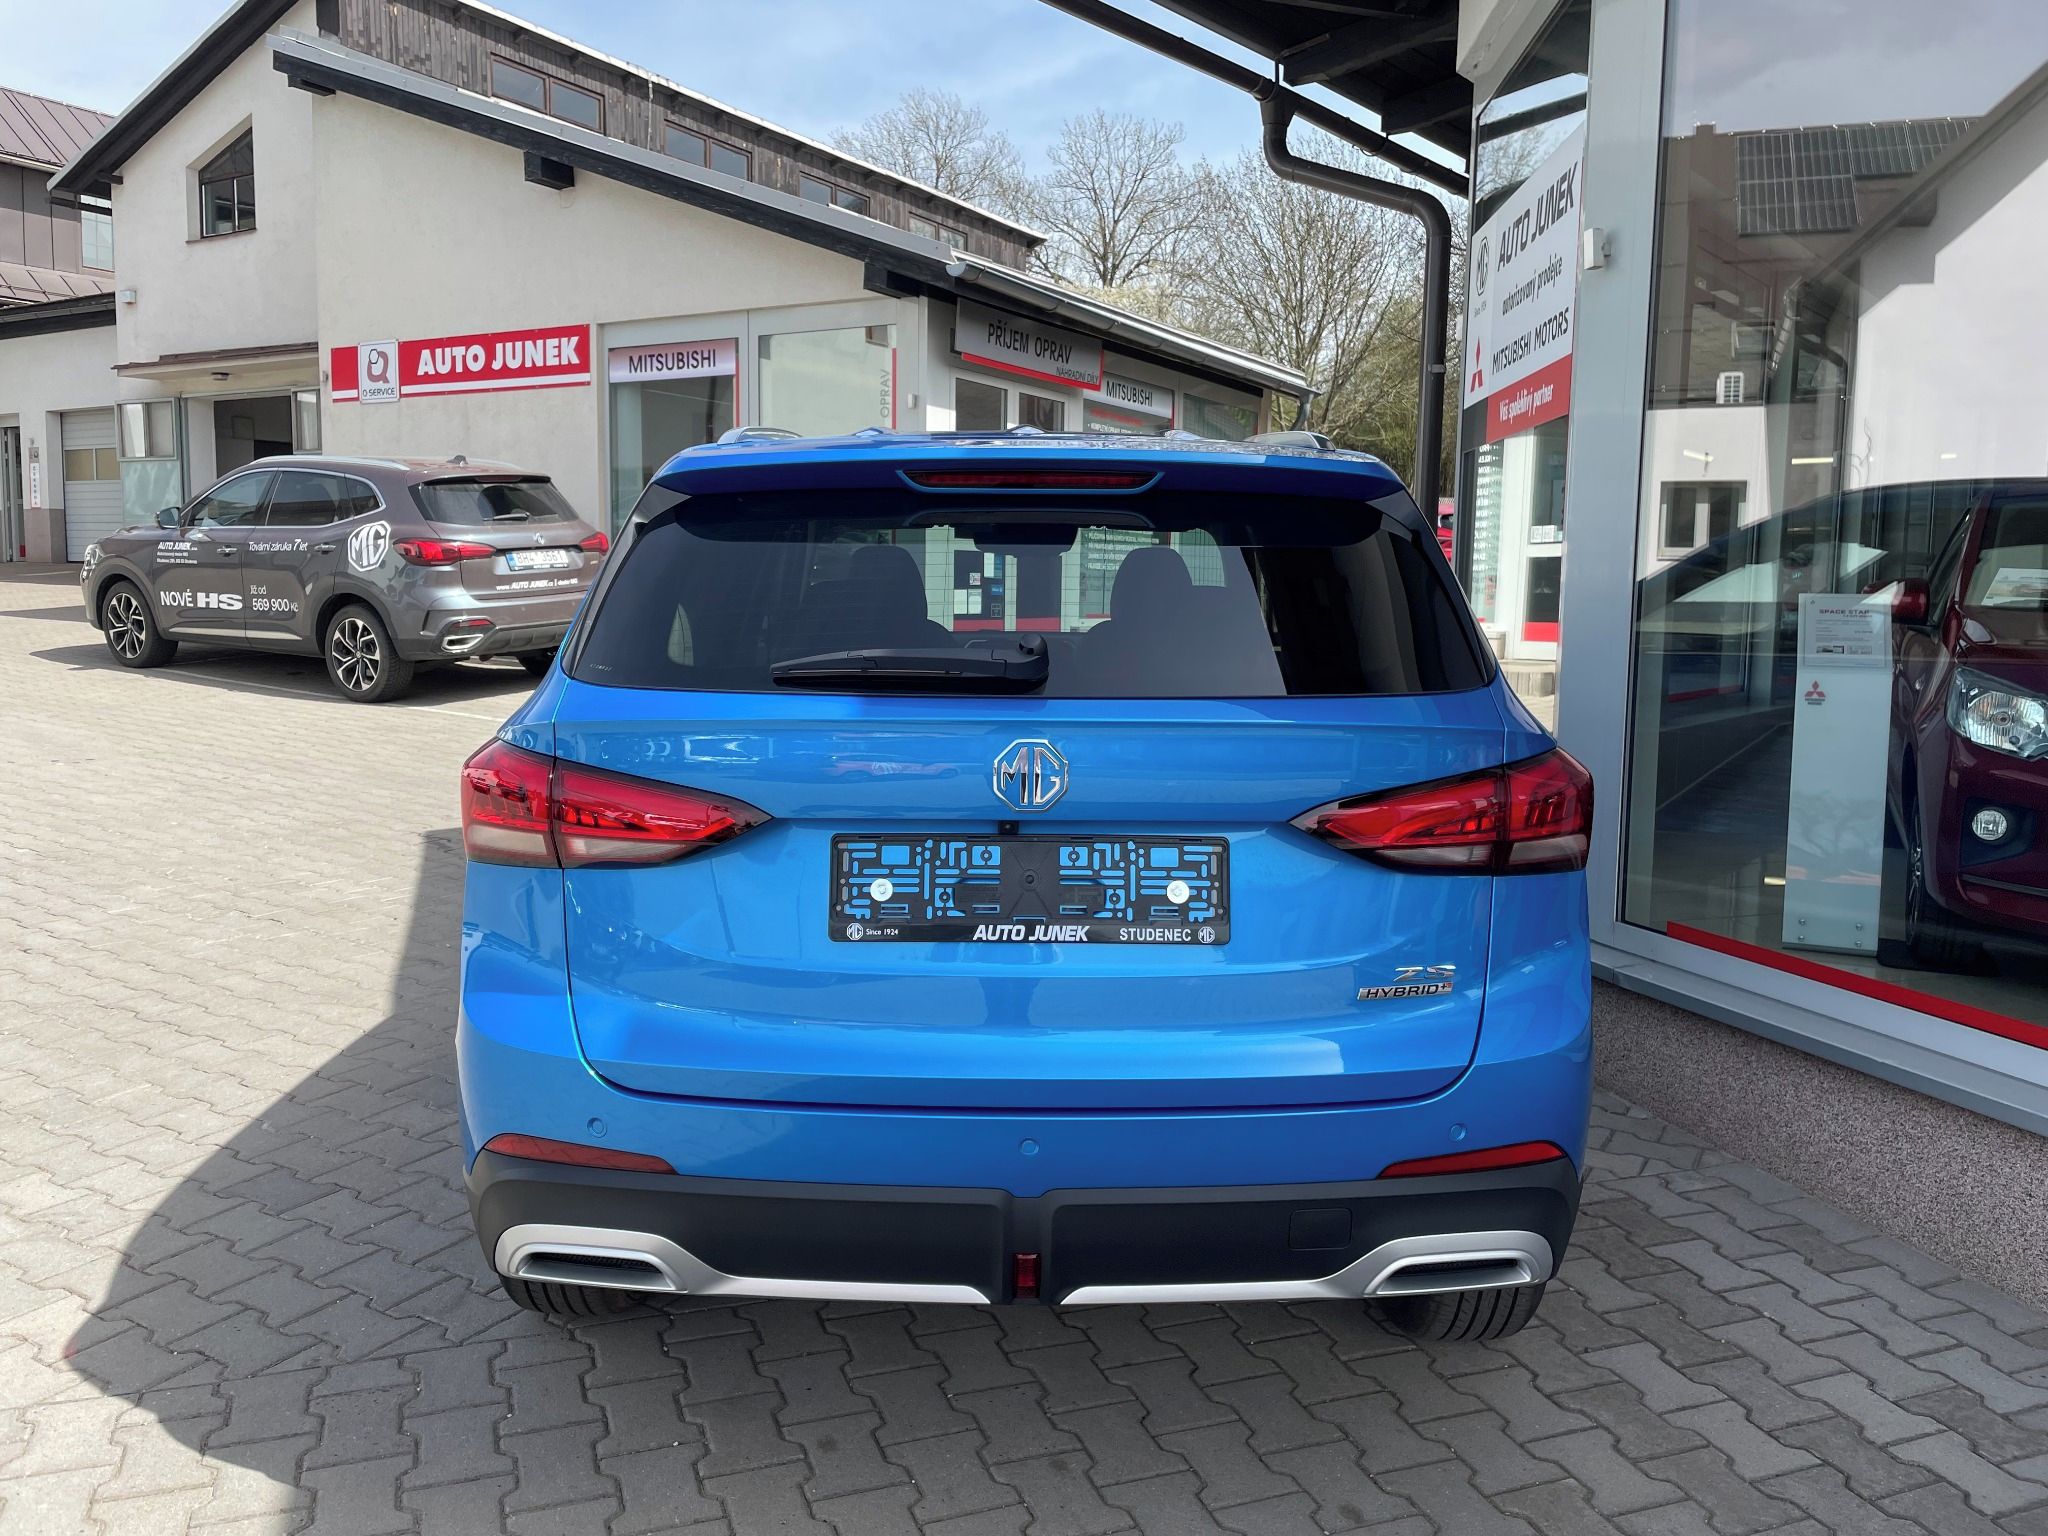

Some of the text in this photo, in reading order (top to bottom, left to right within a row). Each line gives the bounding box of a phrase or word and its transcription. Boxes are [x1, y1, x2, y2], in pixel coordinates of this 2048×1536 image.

[1497, 160, 1578, 272] AUTO JUNEK
[1536, 252, 1563, 300] prodejce
[987, 319, 1073, 365] PŘÍJEM OPRAV
[1492, 331, 1532, 375] MITSUBISHI
[1533, 306, 1569, 351] MOTORS
[417, 336, 581, 376] AUTO JUNEK
[628, 348, 717, 374] MITSUBISHI
[368, 387, 396, 397] SERVICE
[880, 369, 890, 418] OPRAV
[1106, 380, 1153, 408] MITSUBISHI
[157, 541, 174, 550] AUTO
[173, 541, 192, 551] JUNEK
[293, 538, 302, 551] 7
[299, 541, 308, 552] let
[350, 523, 387, 568] MG
[160, 588, 243, 611] NOVÉ HS
[258, 584, 267, 595] od
[252, 598, 270, 611] 569
[271, 598, 290, 612] 900
[1000, 745, 1062, 807] MG
[847, 923, 1215, 943] MG Since 1924 AUTO JUNEK STUDENEC MG
[1393, 964, 1457, 982] ZS
